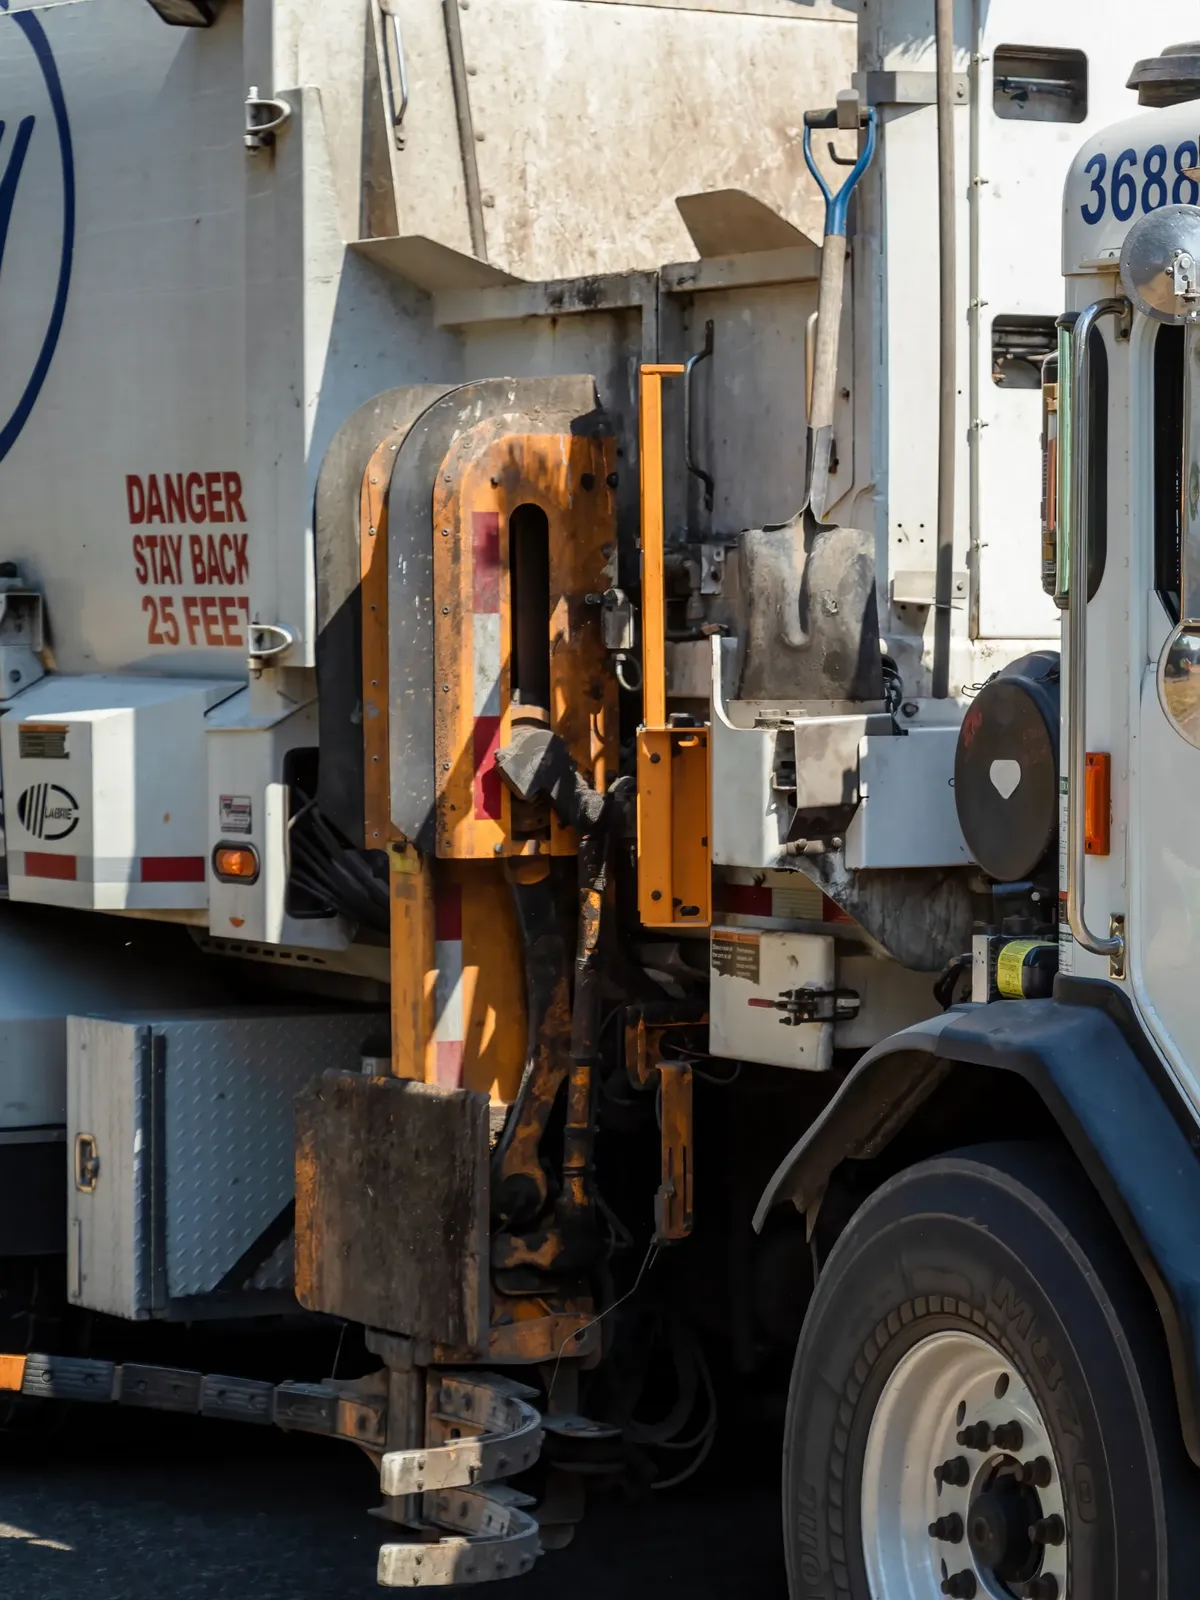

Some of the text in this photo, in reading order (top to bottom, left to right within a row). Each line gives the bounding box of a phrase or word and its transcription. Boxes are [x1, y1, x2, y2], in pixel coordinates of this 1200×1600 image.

[1080, 140, 1199, 225] 3688
[126, 472, 248, 524] DANGER
[133, 533, 249, 585] STAY BACK
[142, 595, 180, 645] 25
